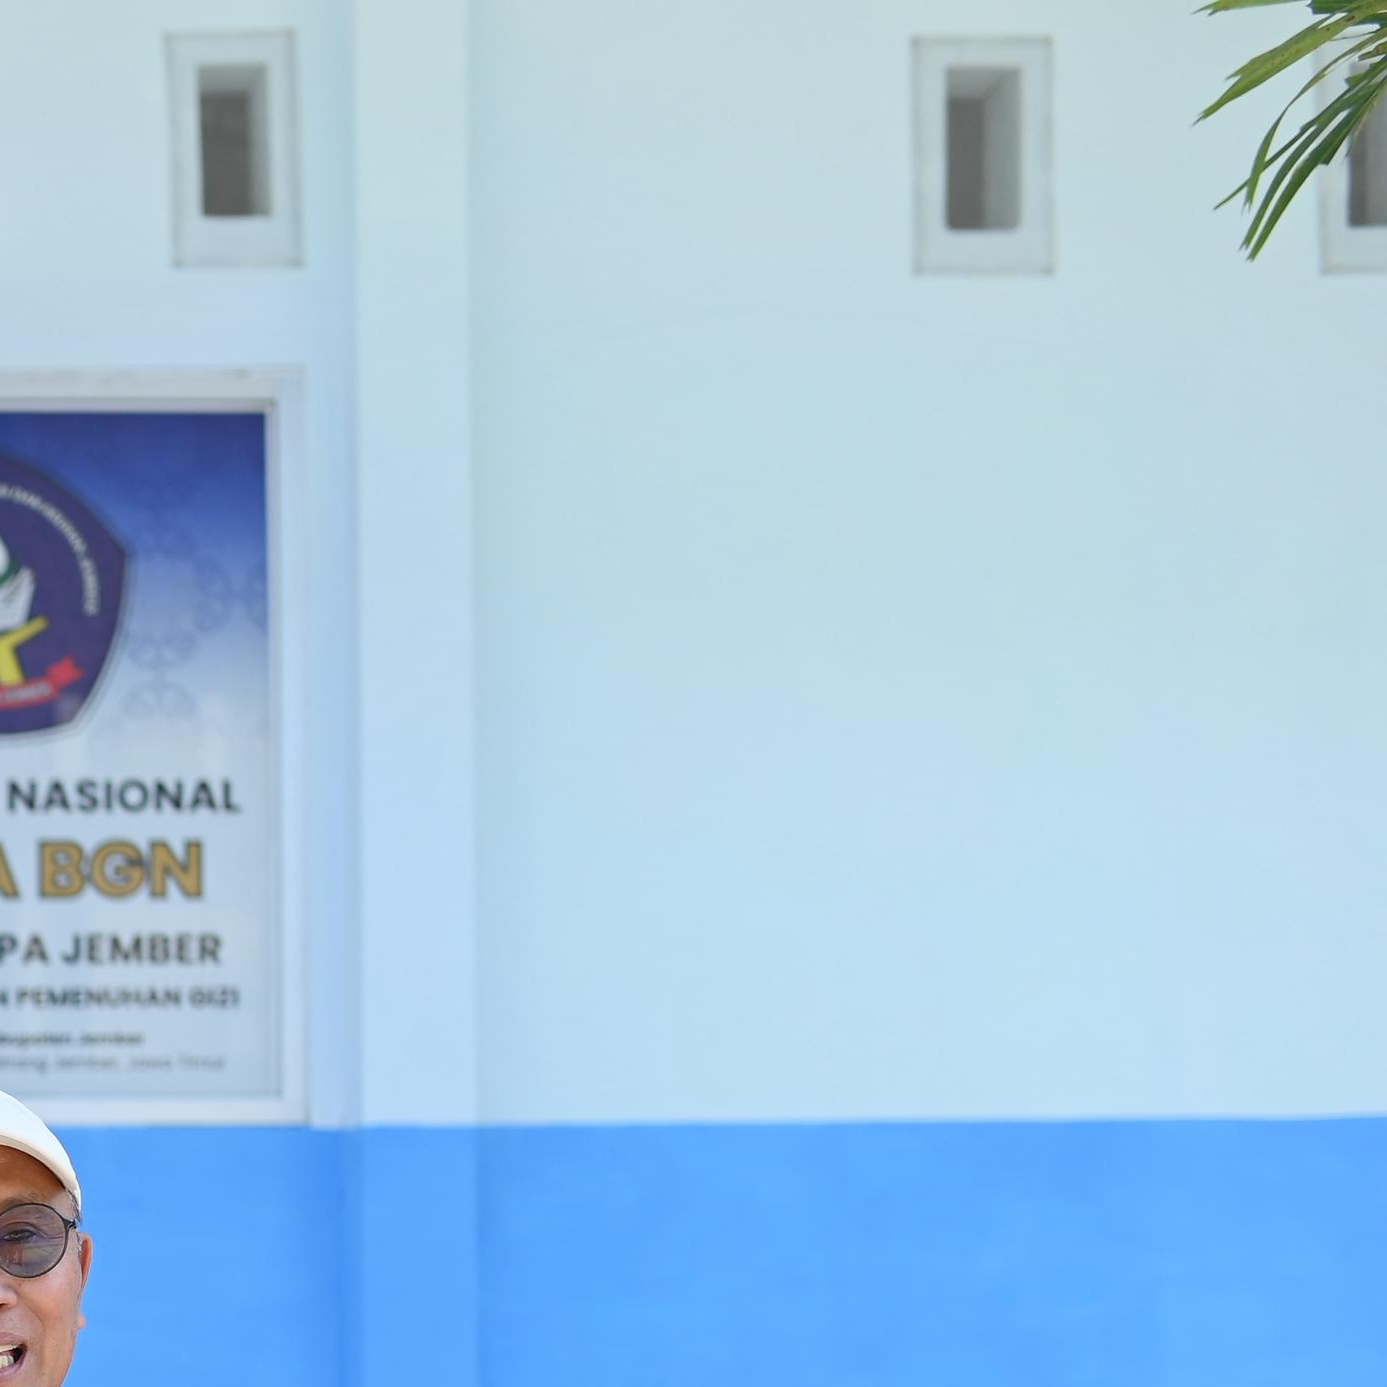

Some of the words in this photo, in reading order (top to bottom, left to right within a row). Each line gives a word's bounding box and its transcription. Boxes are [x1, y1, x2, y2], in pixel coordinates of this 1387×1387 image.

[7, 779, 242, 814] NASIONAL
[37, 838, 205, 900] BGN
[61, 933, 223, 966] JEMBER
[16, 985, 182, 1008] PEMENUHAN
